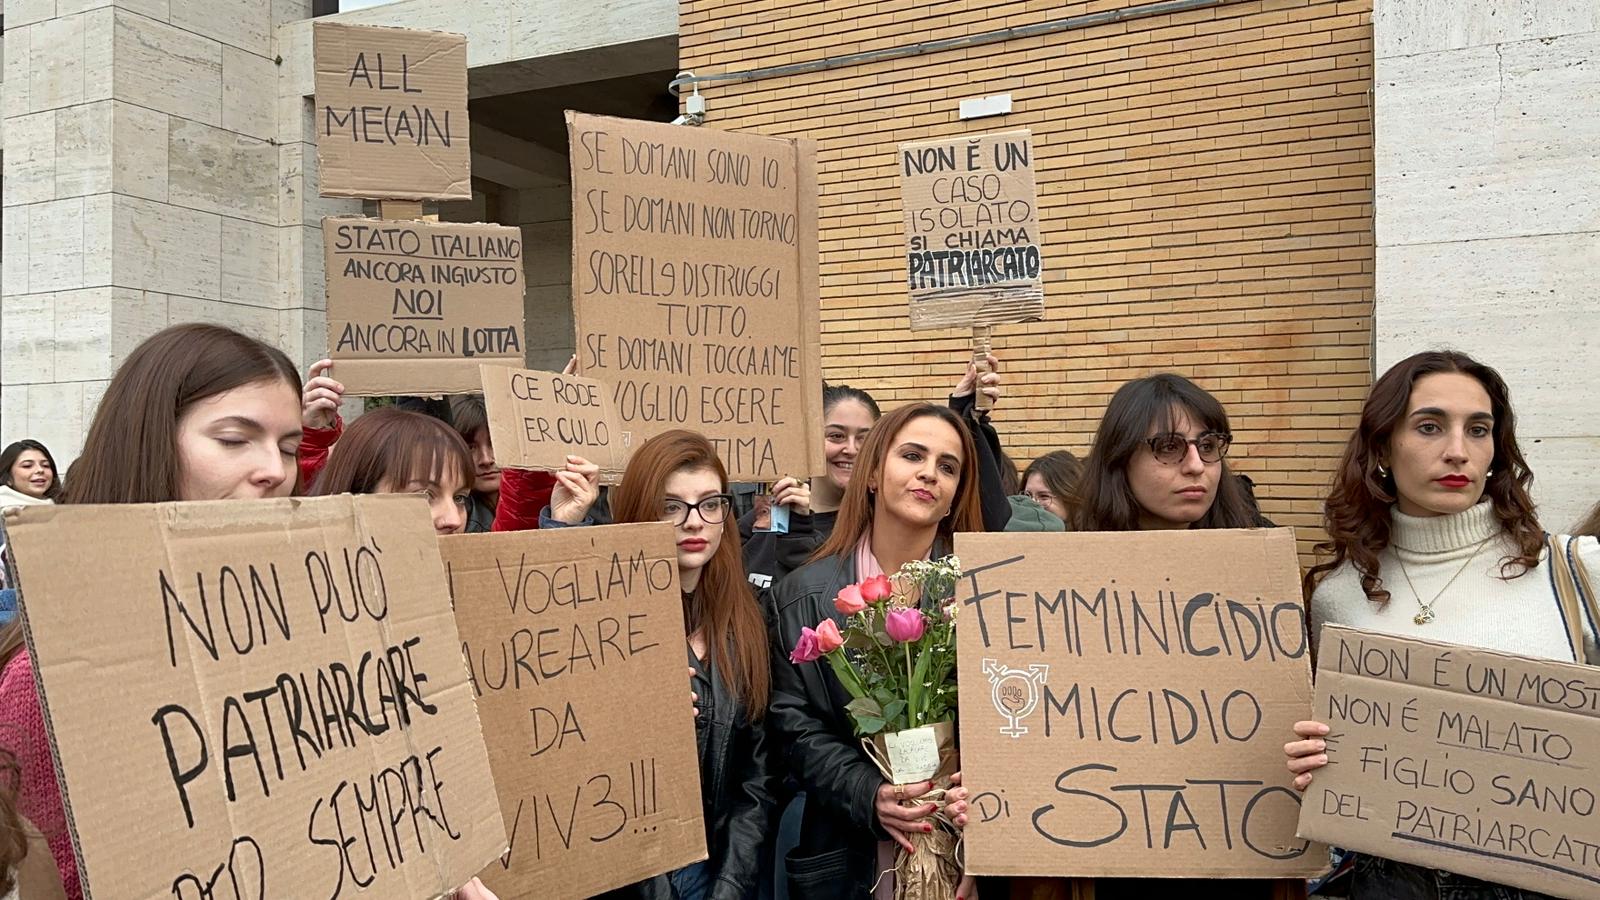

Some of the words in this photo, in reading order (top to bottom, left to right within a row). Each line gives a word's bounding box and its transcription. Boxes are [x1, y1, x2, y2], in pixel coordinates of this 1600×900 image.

[349, 52, 422, 93] ALL
[326, 104, 451, 147] ME(A)N
[581, 131, 613, 174] SE
[622, 137, 696, 182] DOMANI
[707, 149, 750, 186] SONO
[904, 146, 956, 177] NON
[994, 140, 1029, 172] UN
[932, 174, 1001, 203] CASO
[585, 189, 613, 234] SE
[624, 195, 695, 236] DOMANI
[702, 204, 735, 240] NON
[335, 225, 421, 255] STATO
[431, 234, 520, 259] ITALIANO
[911, 235, 927, 251] SI
[945, 227, 1031, 250] CHIAMA
[344, 258, 425, 284] ANCORA
[432, 264, 517, 287] INGIUSTO
[683, 261, 780, 300] DISTRUGGI
[908, 245, 1040, 290] PATRIARCATO
[392, 288, 443, 316] NOI
[337, 323, 431, 353] ANCORA
[438, 328, 454, 354] IN
[463, 326, 520, 357] LOTTA
[586, 334, 608, 370] SE
[618, 336, 692, 377] DOMANI
[511, 374, 543, 401] CE
[552, 378, 599, 407] RODE
[701, 386, 785, 426] ESSERE
[524, 417, 555, 442] ER
[557, 417, 609, 446] CULO
[496, 537, 673, 615] VOGLIAMO
[159, 563, 290, 667] NON
[963, 555, 1307, 663] FEMMINICIDIO
[462, 614, 660, 697] AUREARE
[1339, 638, 1410, 681] NON
[1466, 662, 1506, 698] UN
[151, 636, 438, 829] PATRIARCARE
[530, 701, 586, 757] DA
[1329, 693, 1391, 728] NON
[1437, 711, 1573, 761] MALATO
[1360, 743, 1475, 796] FIGLIO
[1491, 775, 1596, 817] SANO
[308, 746, 461, 900] SEMPRE
[1031, 763, 1311, 859] STATO
[1322, 789, 1369, 821] DEL
[1395, 800, 1600, 868] PATRIARCAT
